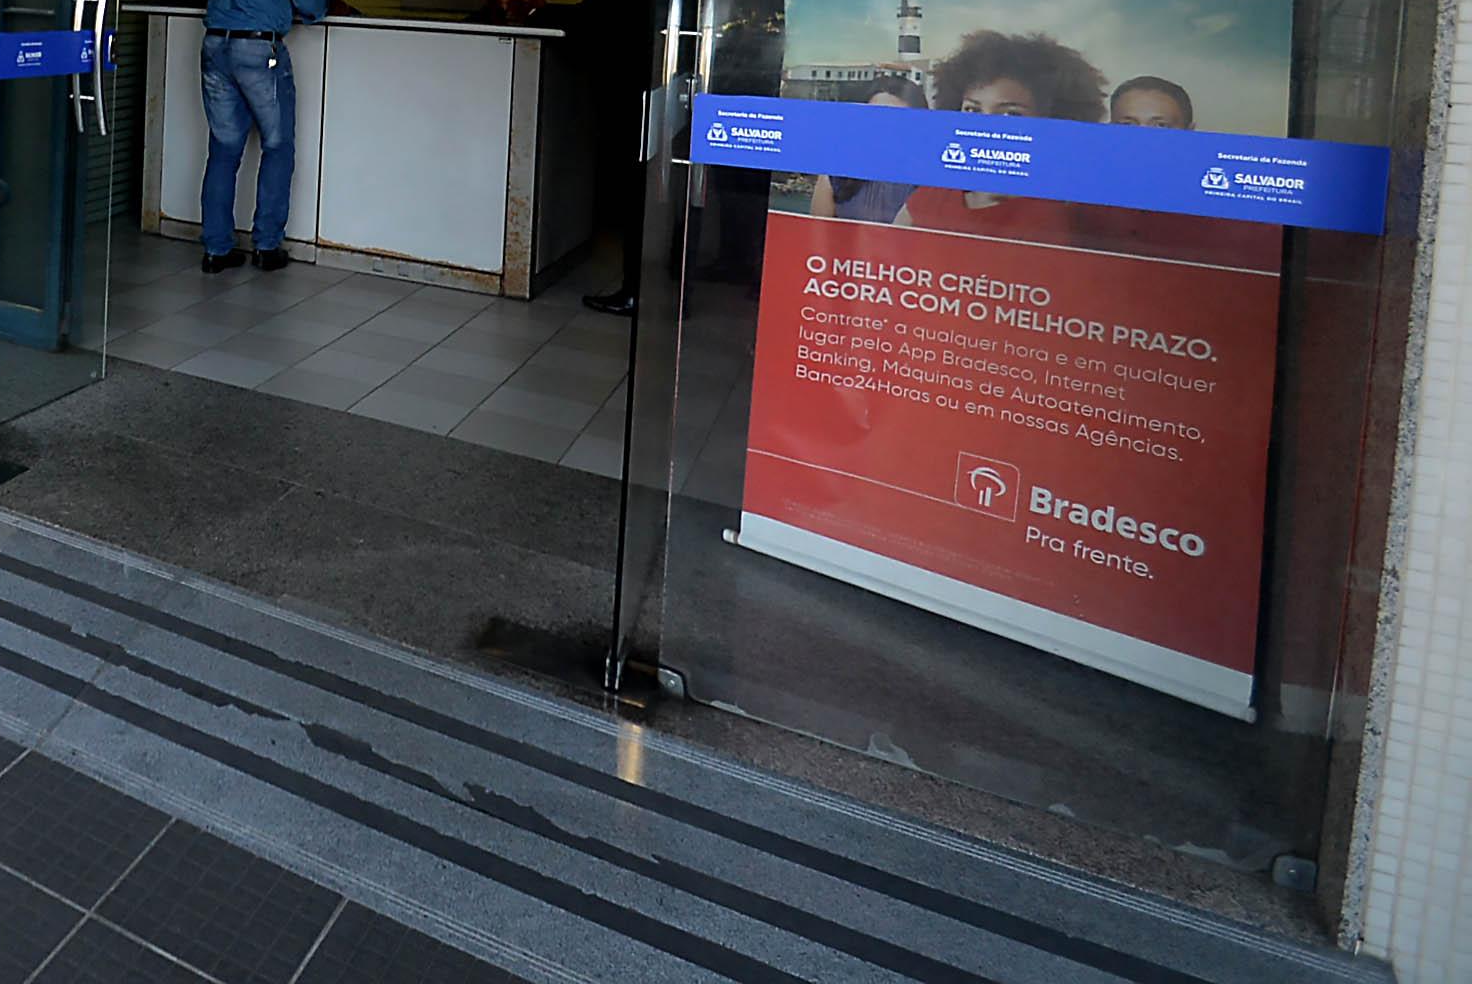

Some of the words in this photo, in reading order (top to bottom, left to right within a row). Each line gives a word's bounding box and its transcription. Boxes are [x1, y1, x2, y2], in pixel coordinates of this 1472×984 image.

[731, 127, 782, 140] SALVADOR
[970, 148, 1030, 163] SALVADOR
[1218, 153, 1258, 162] Secretaria
[1272, 158, 1307, 166] Fazenda
[1234, 173, 1304, 190] SALVADOR
[806, 256, 826, 274] O
[833, 259, 932, 288] MELHOR
[939, 273, 1050, 306] CRÉDITO
[803, 278, 893, 305] AGORA
[900, 291, 960, 316] COM
[967, 302, 987, 321] O
[995, 306, 1104, 342] MELHOR
[1113, 325, 1218, 362] PRAZO.
[799, 326, 846, 346] lugar
[851, 336, 892, 352] pelo
[898, 343, 936, 363] App
[942, 351, 1036, 384] Bradesco,
[1045, 370, 1126, 400] Internet
[894, 323, 907, 335] a
[913, 327, 997, 352] qualquer
[1004, 340, 1048, 362] hora
[1056, 353, 1068, 366] e
[1075, 356, 1106, 372] em
[1114, 364, 1216, 393] qualquer
[796, 365, 930, 403] Banco24Horas
[936, 395, 959, 410] ou
[965, 402, 994, 418] em
[1001, 409, 1070, 436] nossas
[1075, 424, 1184, 462] Agências.
[883, 360, 974, 392] Máquinas
[979, 381, 1005, 398] de
[1011, 387, 1206, 444] Autoatendimento,
[1029, 486, 1205, 556] Bradesco
[1026, 526, 1064, 554] Pra
[1073, 540, 1154, 580] frente.
